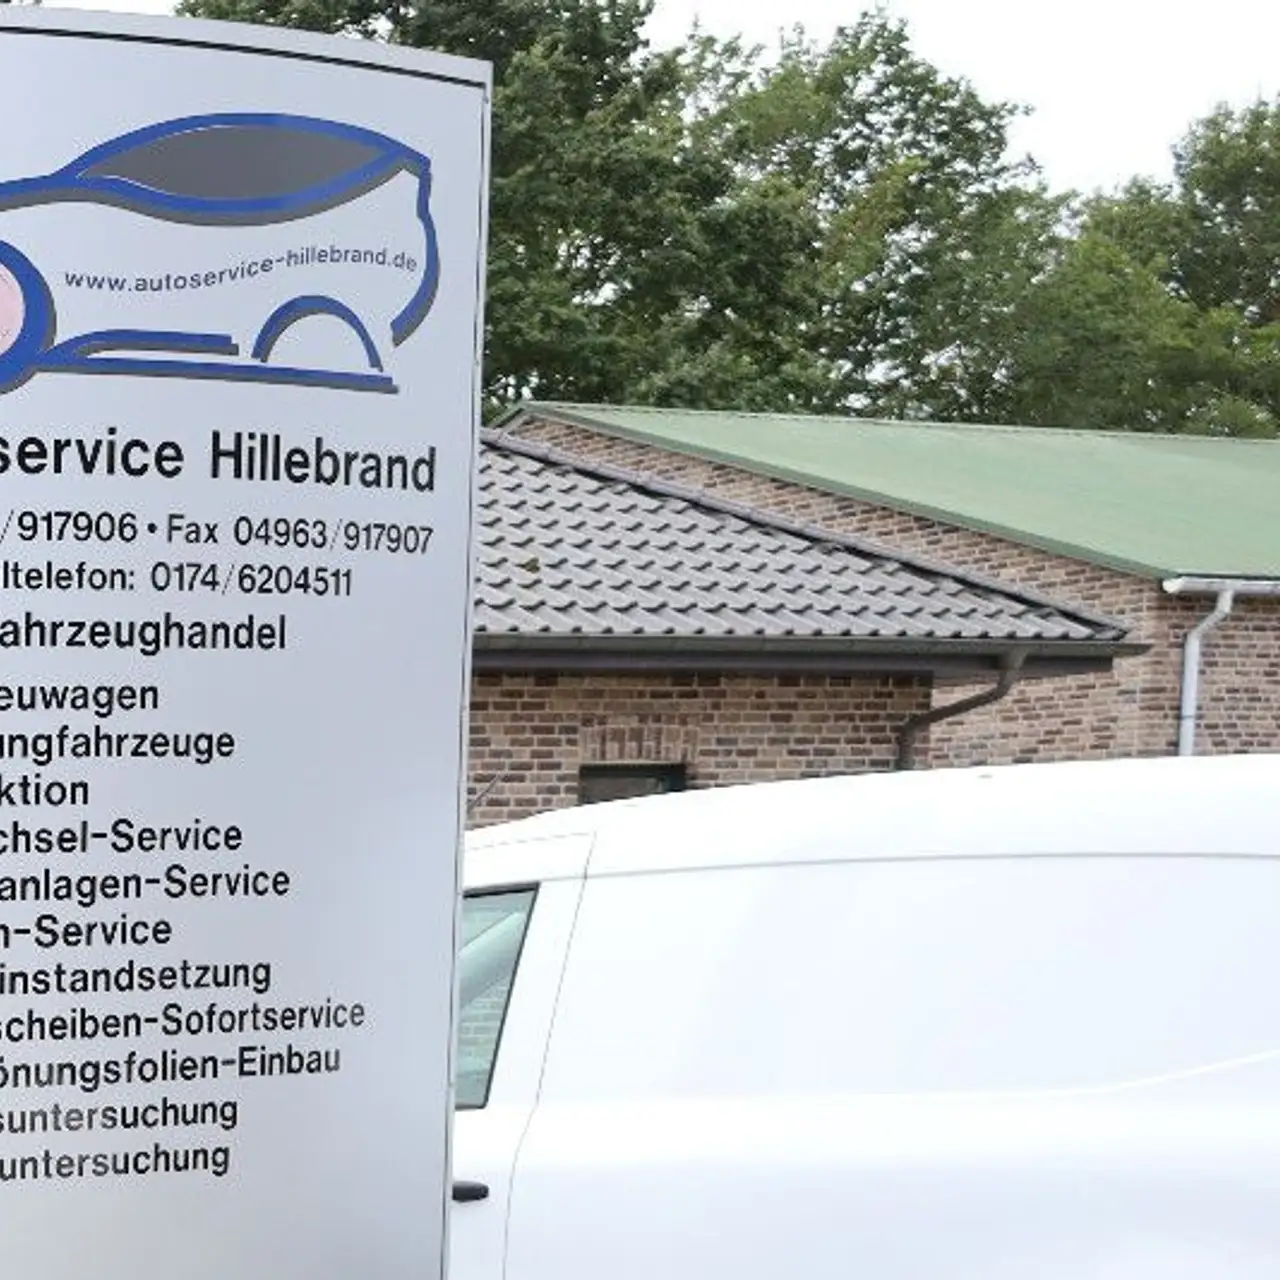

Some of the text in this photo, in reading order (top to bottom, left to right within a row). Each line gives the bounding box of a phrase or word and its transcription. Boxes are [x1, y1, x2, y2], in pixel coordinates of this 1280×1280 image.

[63, 245, 418, 293] www.autoservice-hillebrand.de
[210, 429, 437, 493] Hillebrand
[166, 513, 220, 545] Fax
[233, 515, 435, 555] 04963/917907
[150, 561, 354, 597] 0174/6204511
